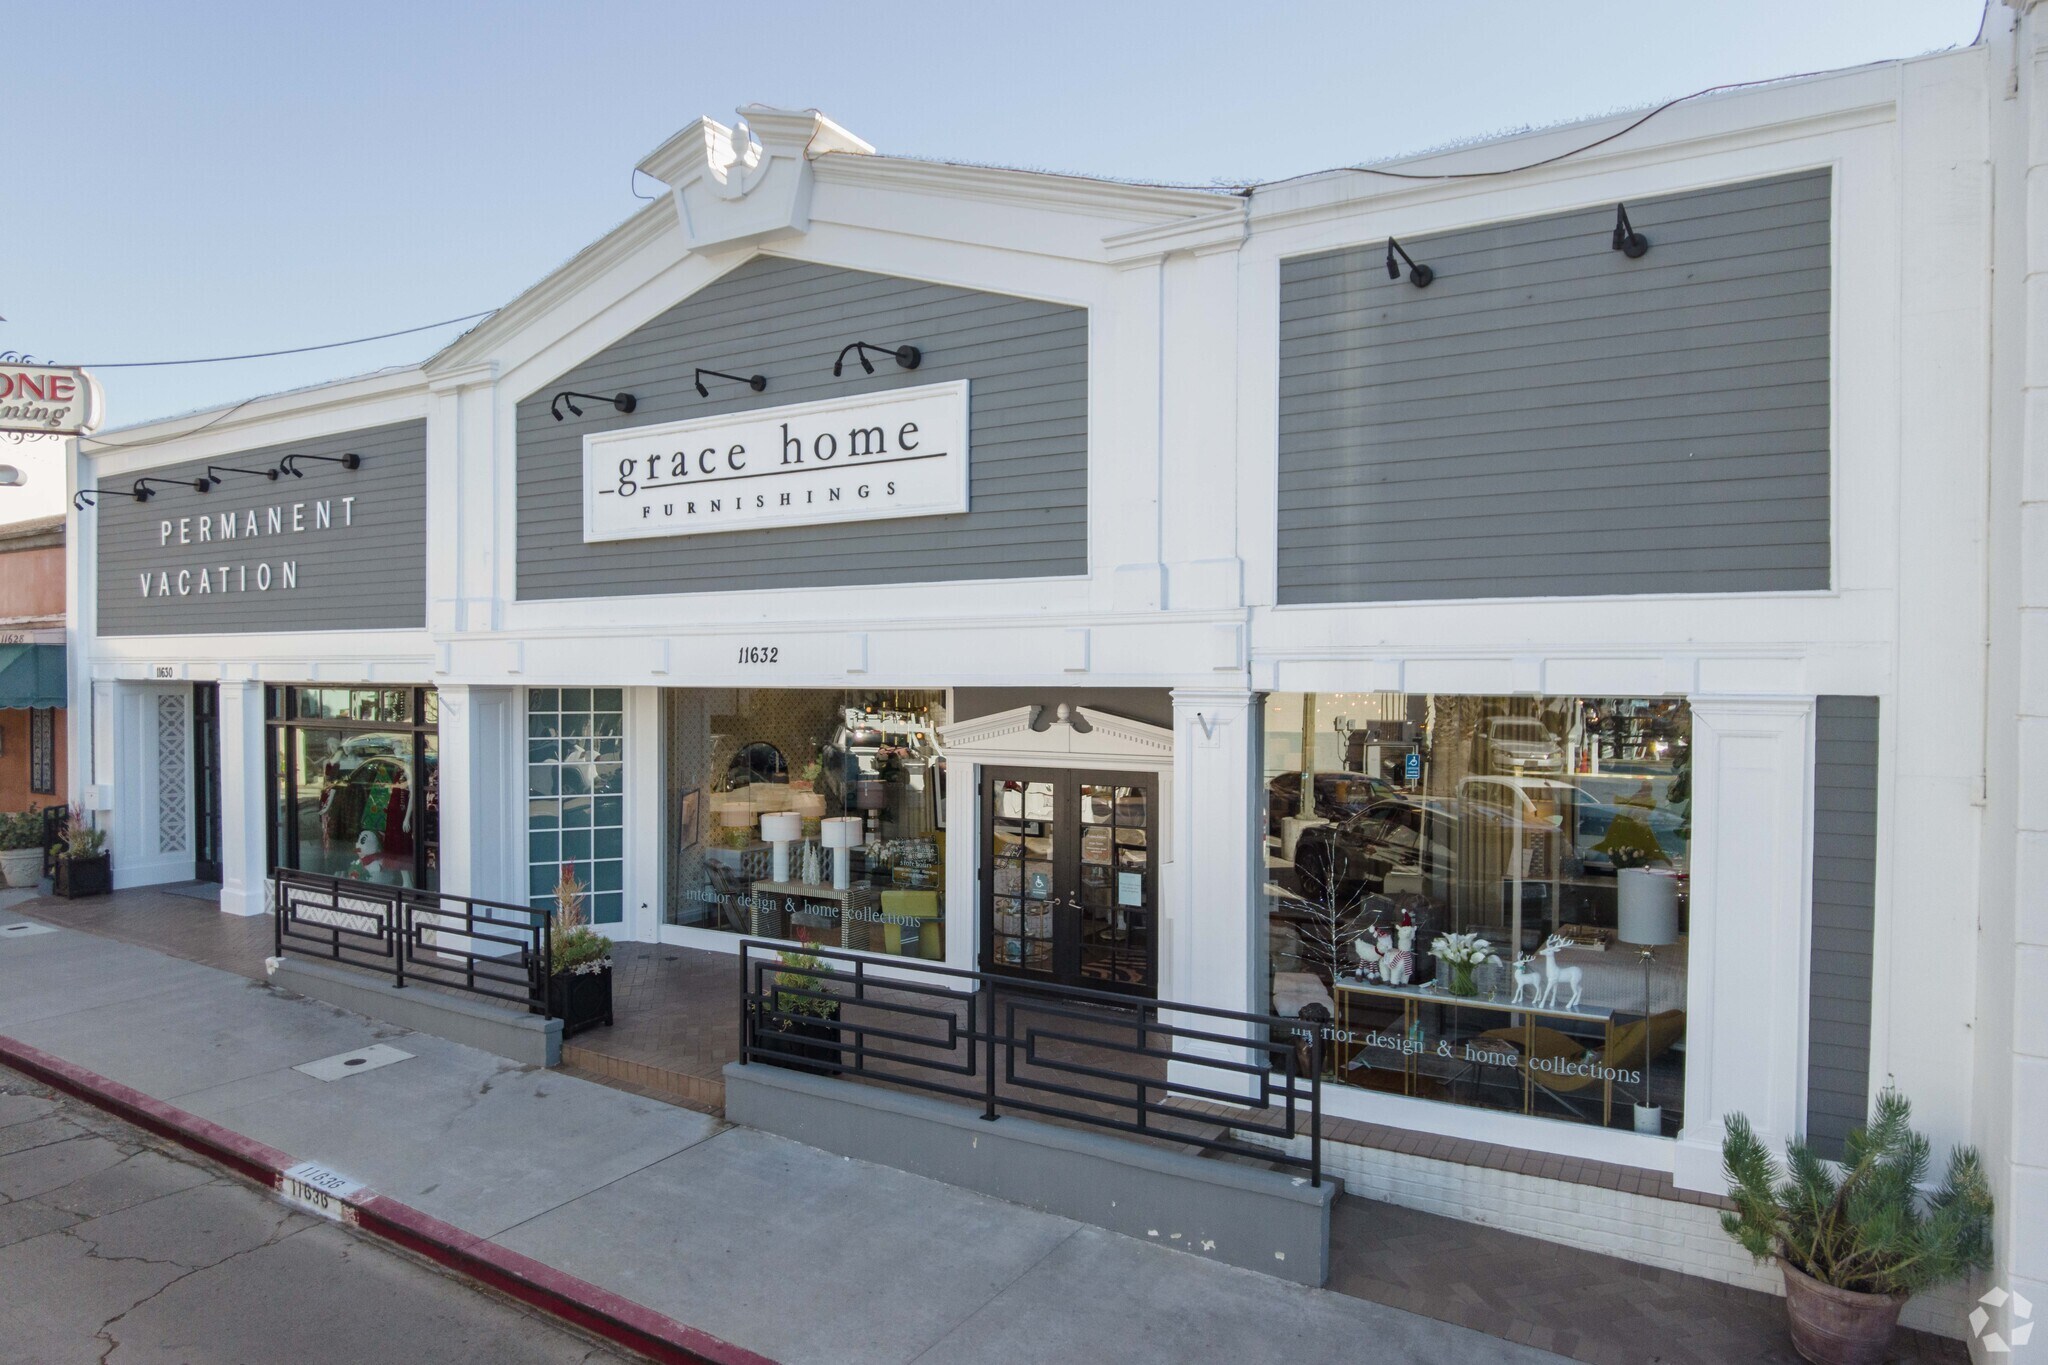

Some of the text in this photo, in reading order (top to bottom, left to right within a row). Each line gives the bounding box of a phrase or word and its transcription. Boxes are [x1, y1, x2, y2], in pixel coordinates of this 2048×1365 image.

[618, 420, 920, 497] grace home
[642, 481, 897, 519] FURNISHINGS
[161, 497, 356, 546] PERMANENT
[140, 560, 298, 598] VACATION
[1, 634, 25, 644] 11628
[738, 646, 779, 664] 11632
[156, 666, 173, 679] 11630
[686, 889, 921, 928] interior design & home collections
[1366, 1030, 1425, 1056] design
[1436, 1039, 1454, 1059] &
[1465, 1043, 1518, 1068] home
[1529, 1055, 1641, 1084] collections
